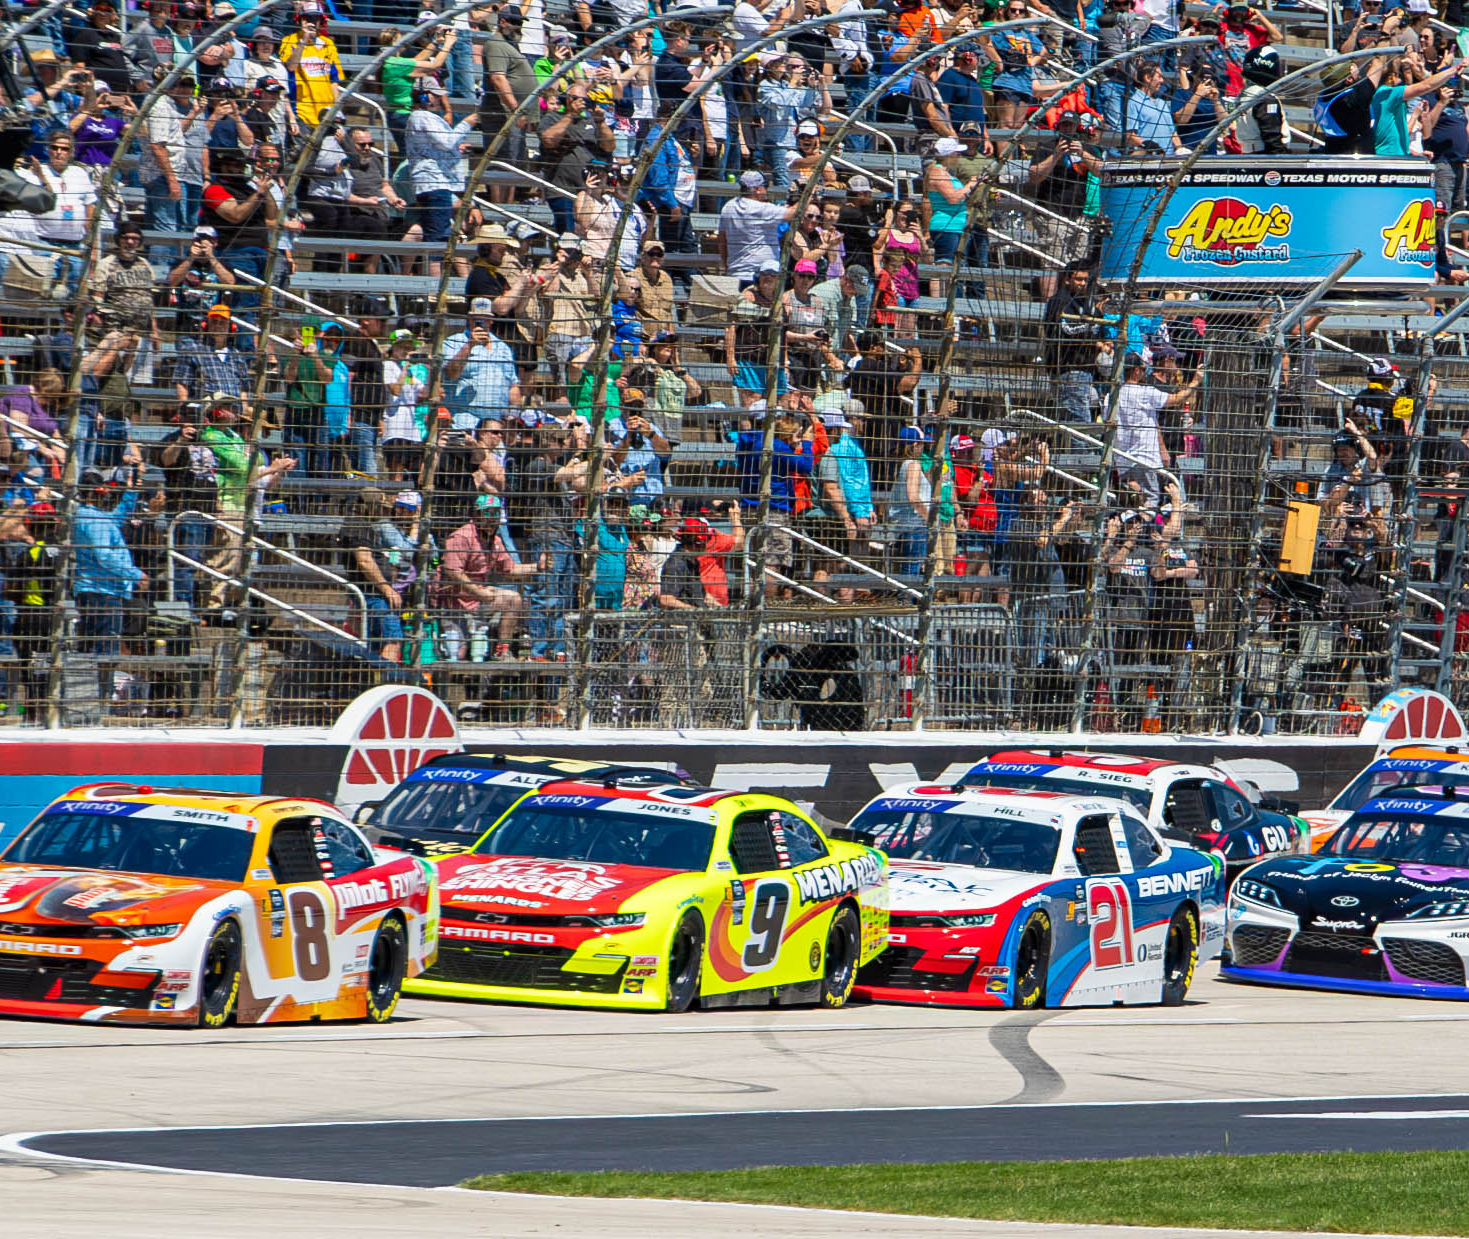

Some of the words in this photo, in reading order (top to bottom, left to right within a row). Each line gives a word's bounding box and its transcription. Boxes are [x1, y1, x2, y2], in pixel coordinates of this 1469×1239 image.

[1145, 174, 1192, 183] MOTR
[1193, 174, 1264, 183] SPEEDWAY
[1282, 174, 1324, 184] TEXAS
[1327, 174, 1377, 184] MOTOR
[1378, 174, 1431, 184] SPEEDWAY
[1167, 200, 1292, 258] Andy's
[1184, 247, 1232, 262] Frozen
[1233, 246, 1289, 262] Custard
[984, 762, 1042, 774] xfinity
[1078, 770, 1093, 779] R.
[1098, 772, 1133, 784] SIEG
[1381, 759, 1438, 771] xfinity
[421, 769, 483, 782] xfinity
[61, 800, 128, 814] xfinity
[173, 808, 230, 823] SMITH
[531, 793, 595, 808] xfinity
[637, 803, 692, 816] JONES
[880, 798, 942, 811] xfinity
[993, 806, 1026, 817] HILL
[1374, 799, 1434, 812] xfinity
[1136, 865, 1214, 898] BENNETT
[332, 878, 389, 921] pilot
[450, 894, 544, 909] MENARDS
[741, 877, 793, 974] 9
[1085, 876, 1135, 971] 21
[1311, 915, 1365, 931] Supra
[284, 886, 333, 982] 8
[979, 966, 1010, 976] ARP
